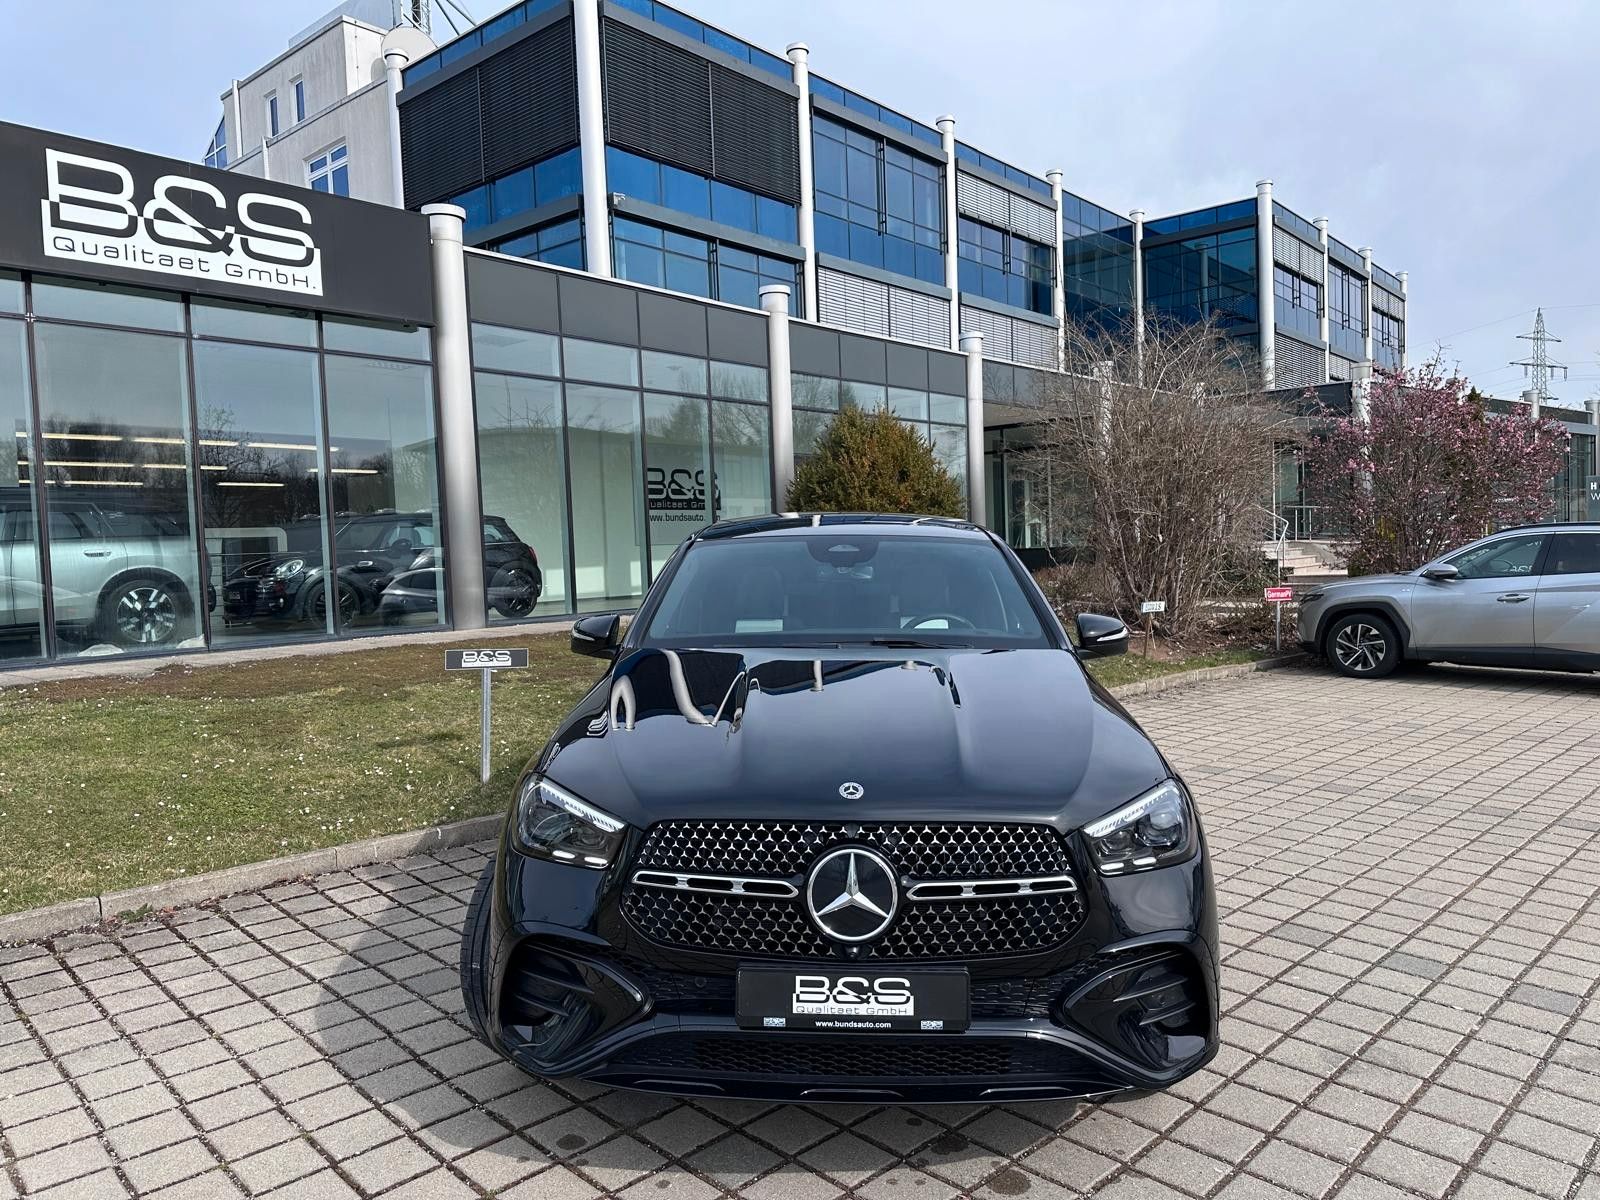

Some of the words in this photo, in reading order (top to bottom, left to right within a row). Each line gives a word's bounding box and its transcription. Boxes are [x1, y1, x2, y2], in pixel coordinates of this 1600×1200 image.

[45, 147, 315, 267] B&S
[53, 236, 210, 273] Qualitaet
[462, 650, 512, 664] B&S
[794, 975, 911, 1006] B&S
[795, 1005, 860, 1015] Qualitaet
[866, 1006, 908, 1016] GmbH
[815, 1019, 892, 1029] www.bundsauto.com
